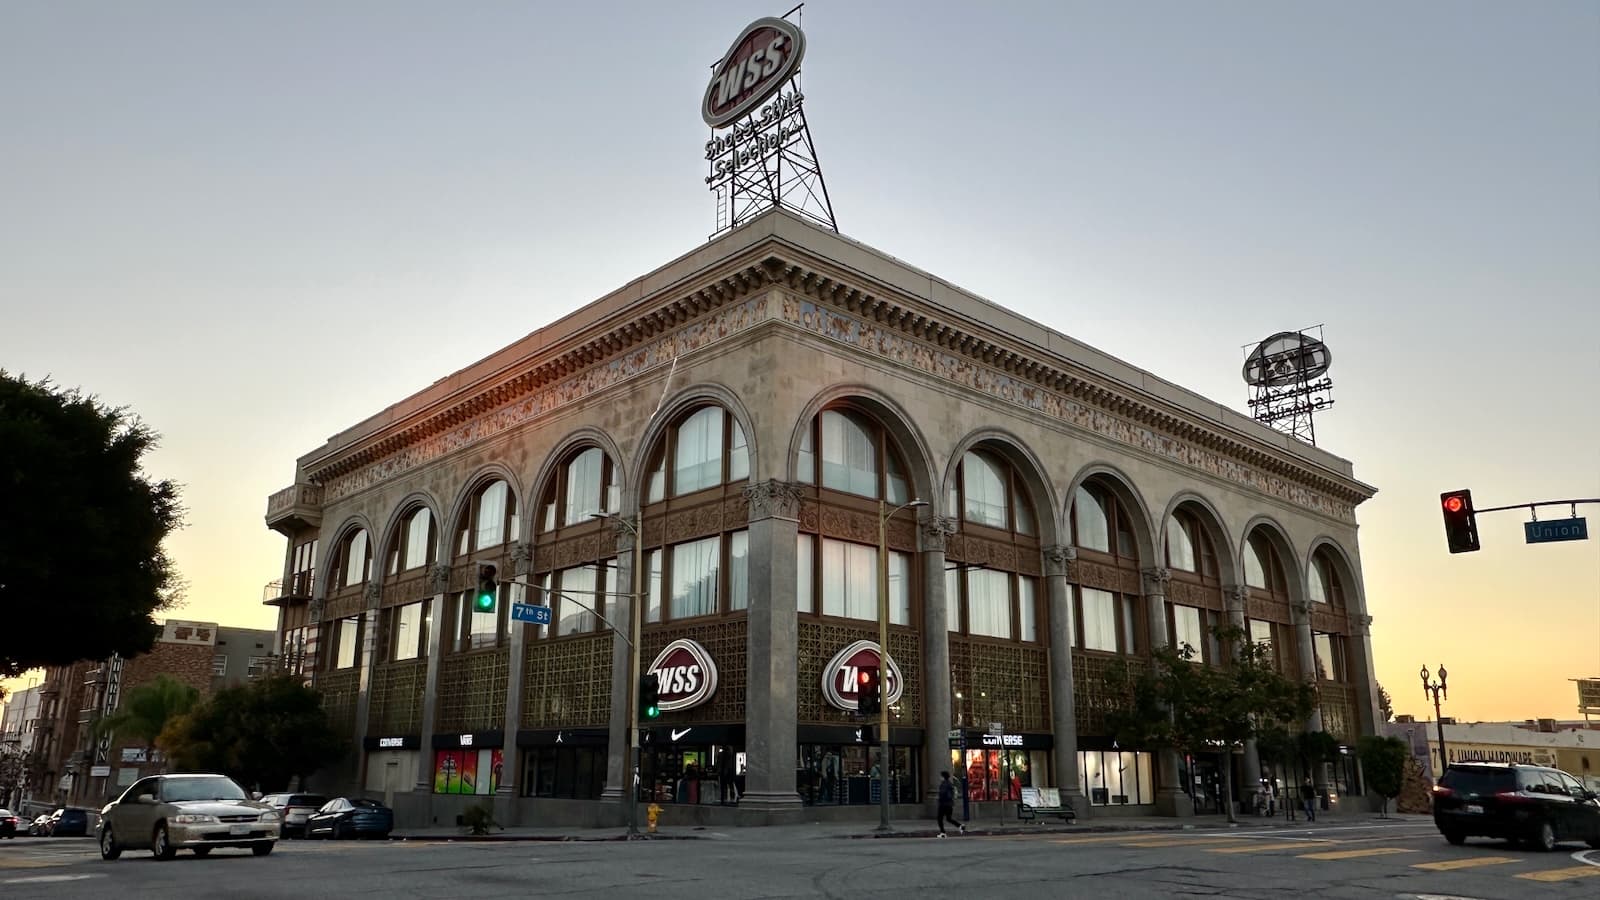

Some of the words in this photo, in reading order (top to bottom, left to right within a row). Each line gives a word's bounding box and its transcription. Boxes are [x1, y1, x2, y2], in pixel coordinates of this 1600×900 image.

[714, 35, 785, 108] WSS
[714, 127, 790, 179] Selection
[1531, 525, 1580, 538] Union
[515, 606, 534, 618] 7th
[536, 610, 549, 621] St
[655, 664, 699, 694] WSS
